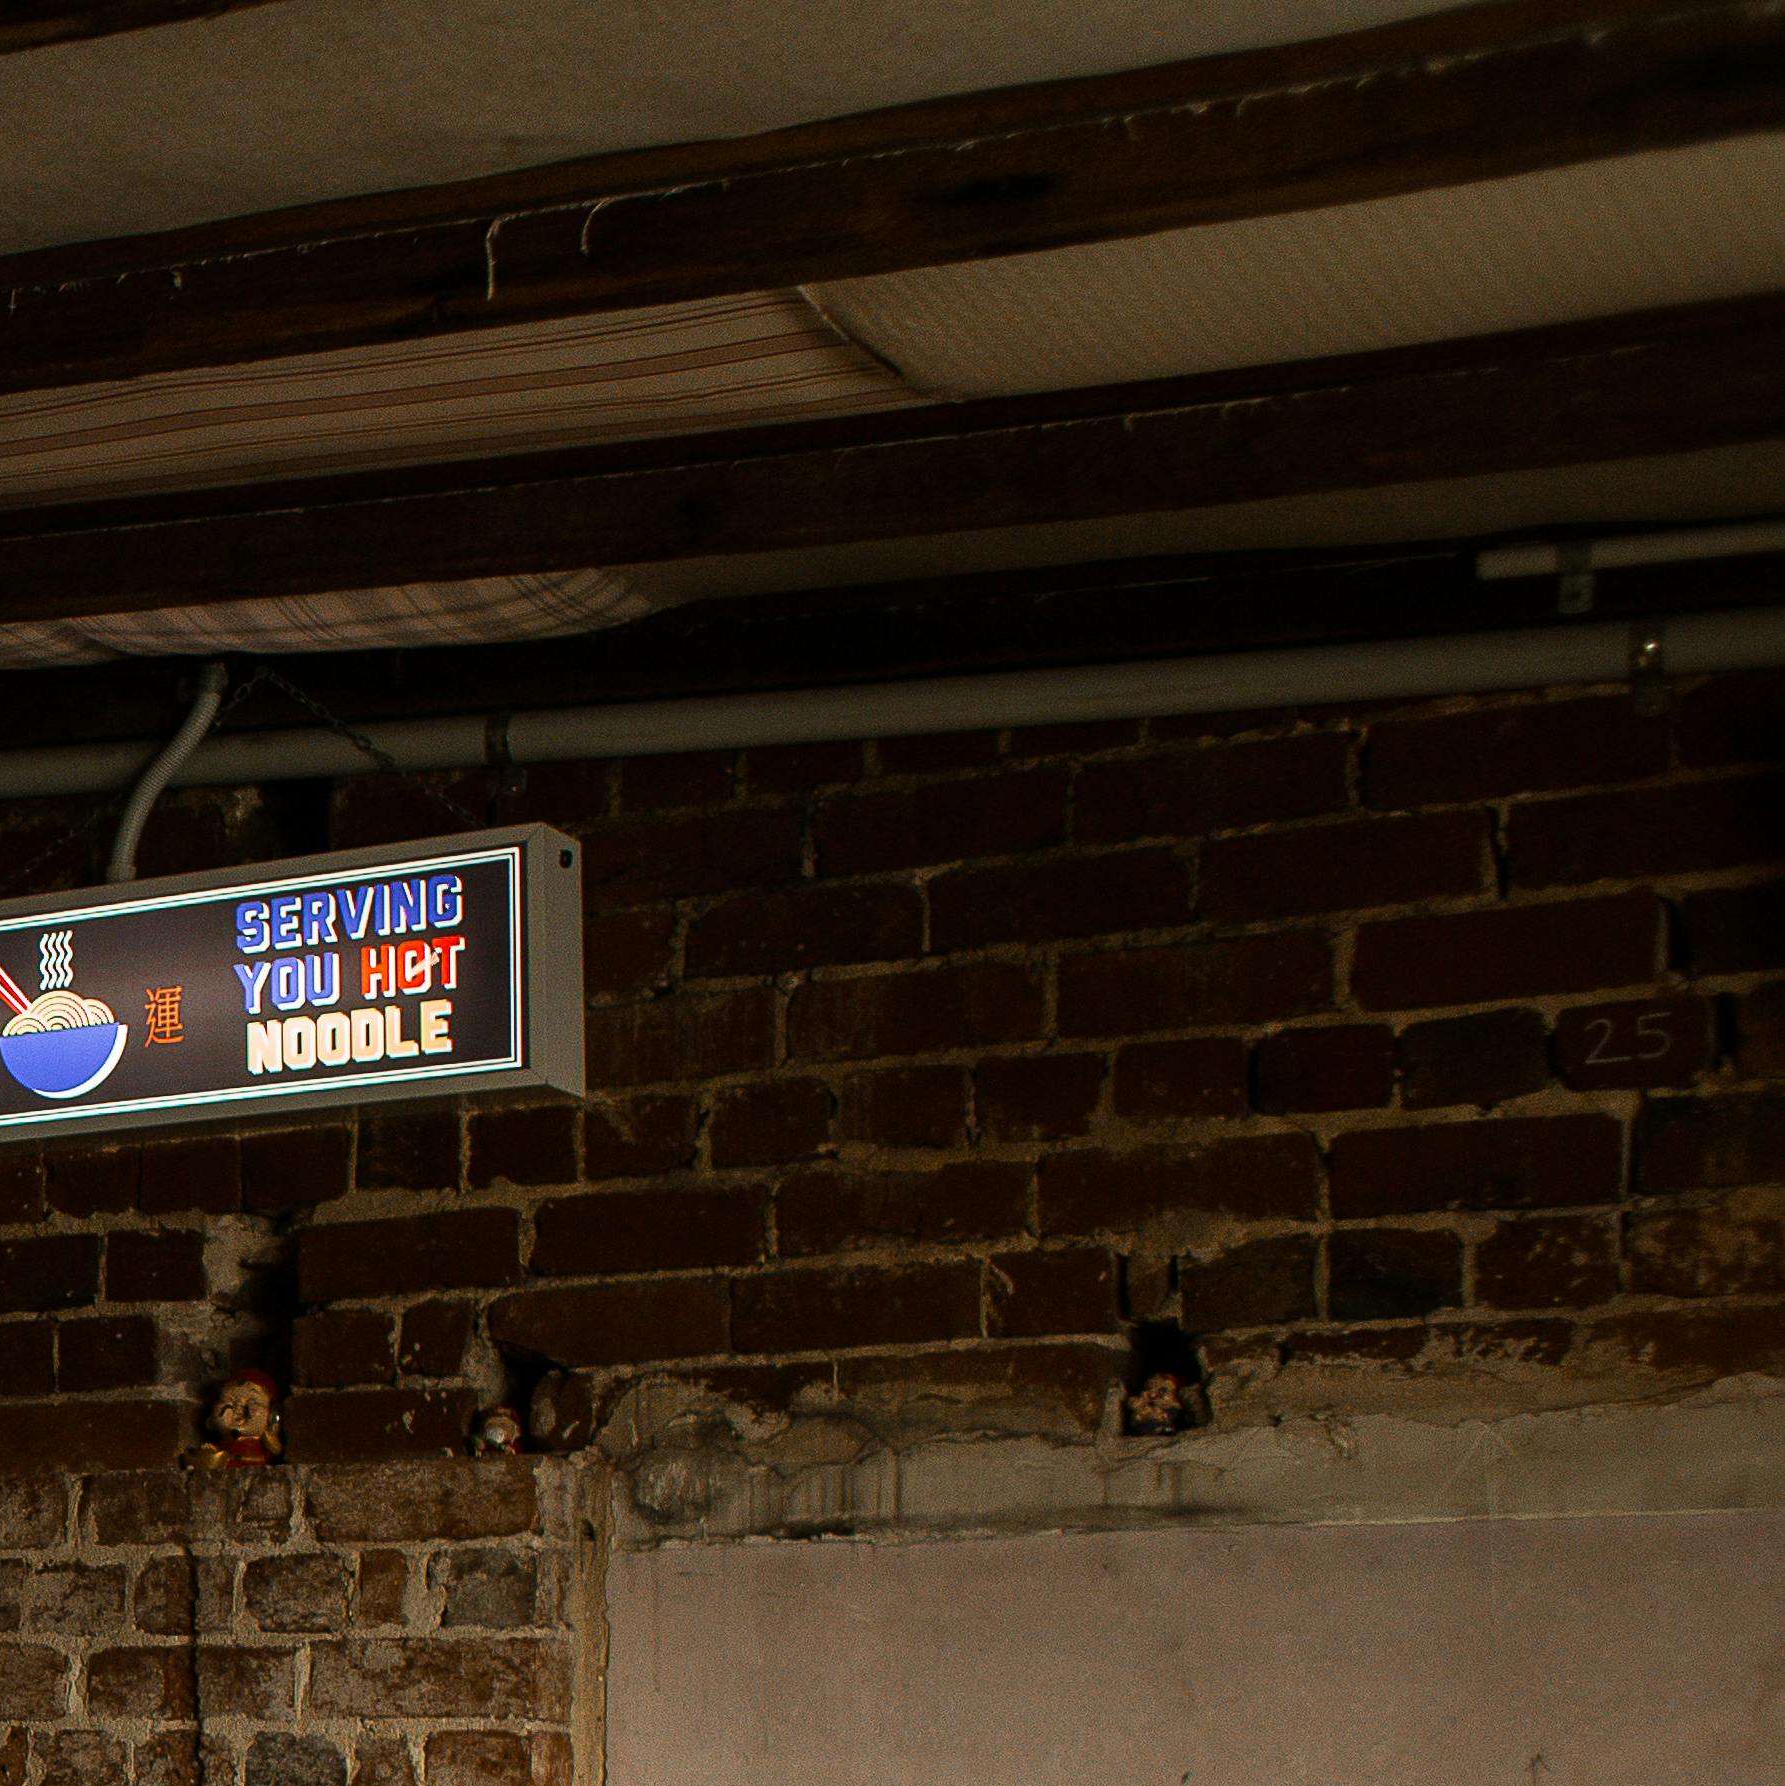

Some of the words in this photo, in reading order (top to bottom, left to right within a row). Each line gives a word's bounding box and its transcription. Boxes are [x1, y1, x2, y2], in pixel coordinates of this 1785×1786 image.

[234, 873, 464, 954] SERVING
[232, 950, 343, 1015] YOU
[359, 933, 467, 999] HOT
[144, 984, 186, 1050] 運
[246, 997, 455, 1076] NOODLE
[1582, 1010, 1673, 1065] 25
